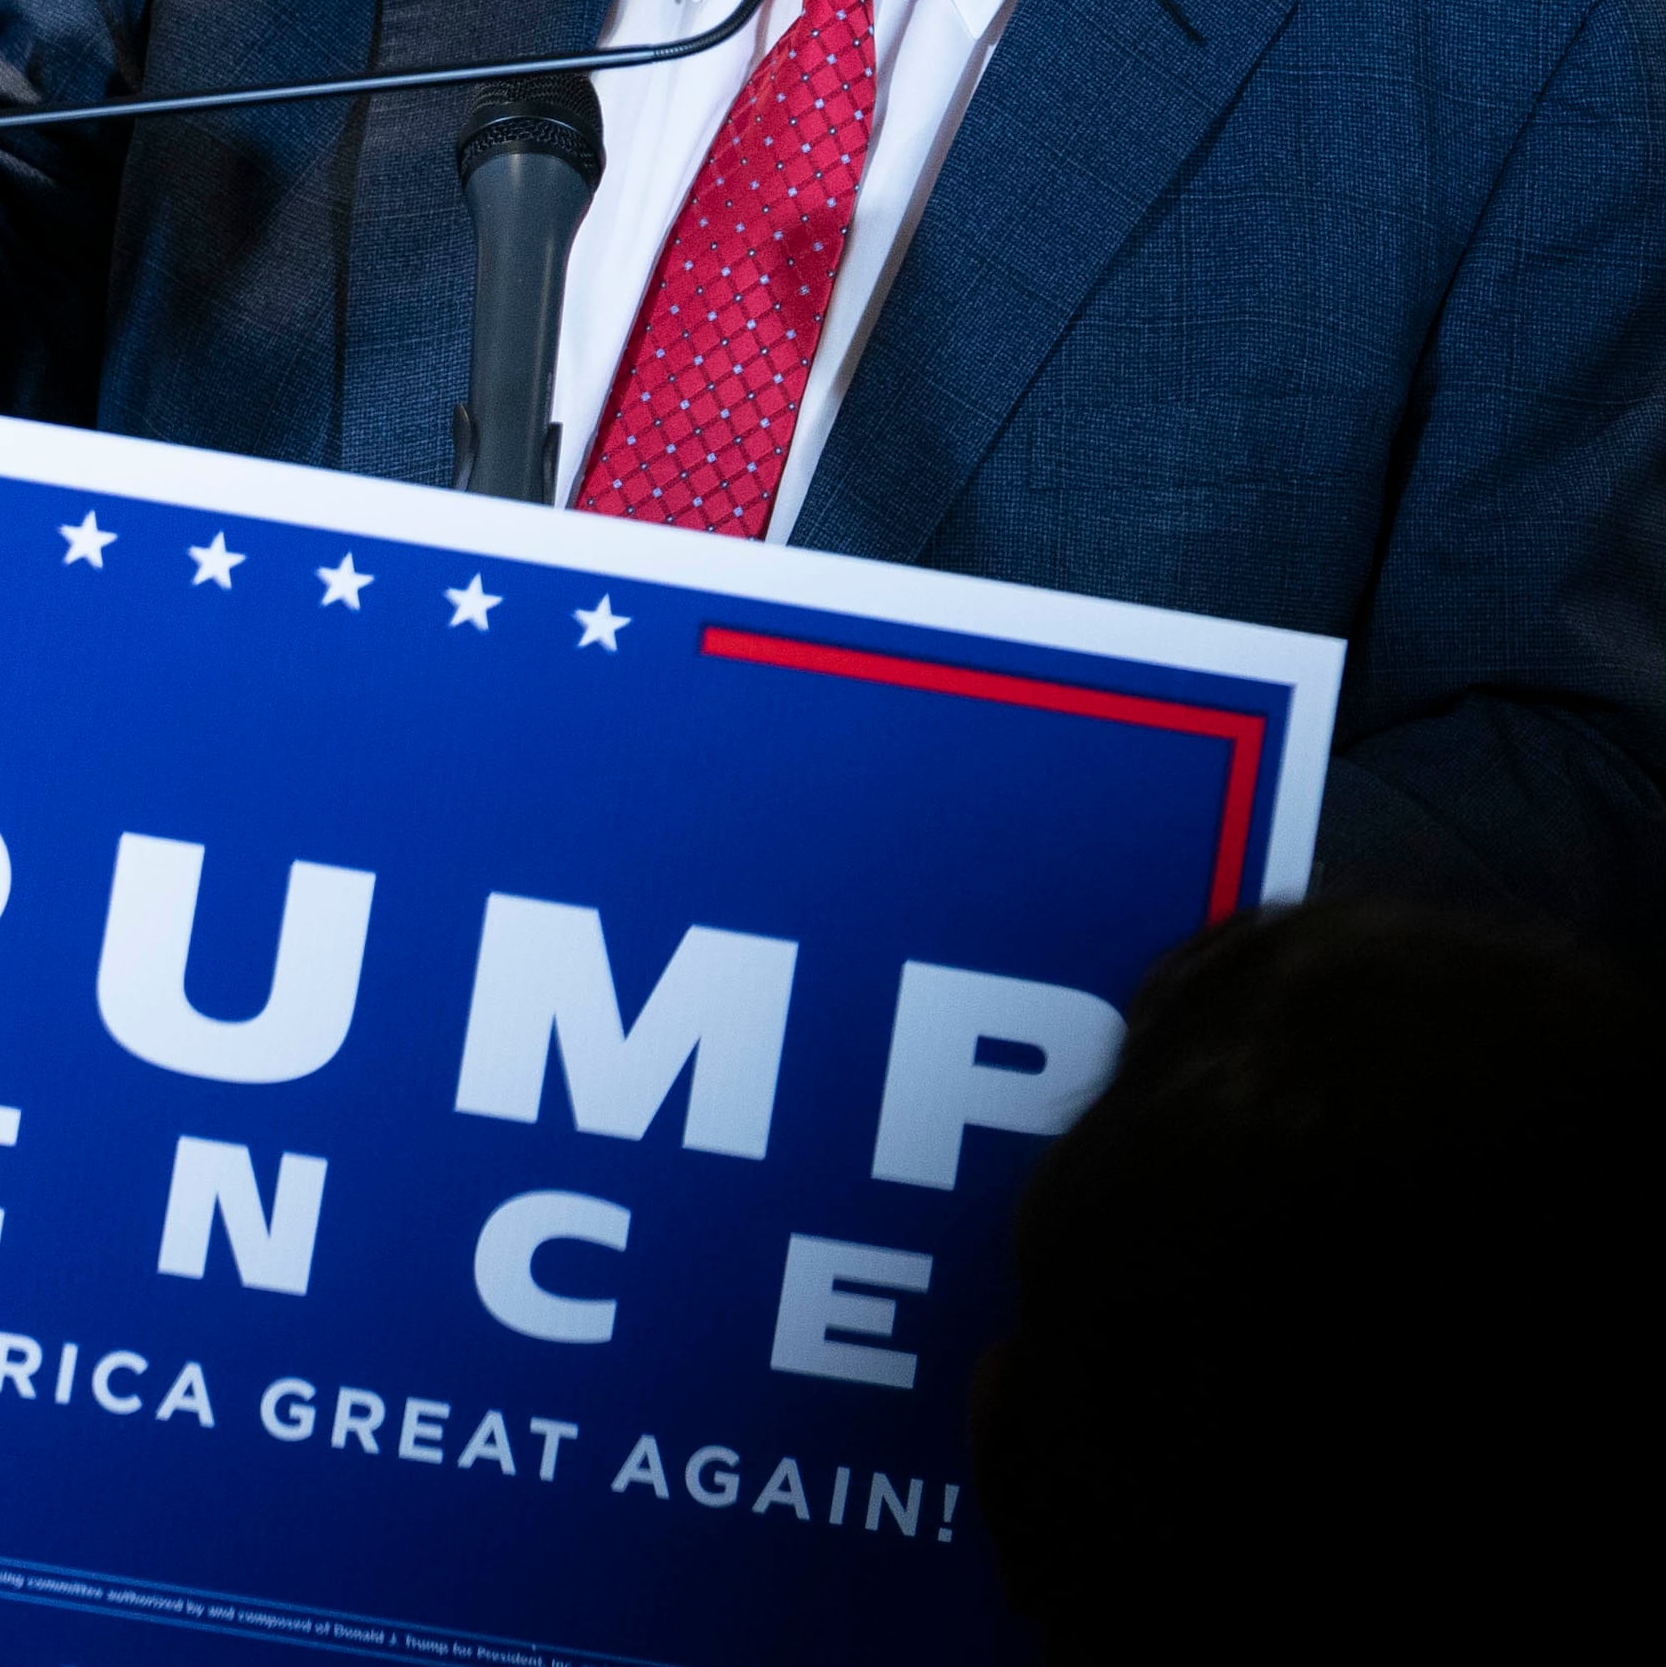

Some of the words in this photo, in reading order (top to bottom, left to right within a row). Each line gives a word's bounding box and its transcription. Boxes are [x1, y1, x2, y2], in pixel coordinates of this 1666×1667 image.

[260, 1379, 580, 1481] GREAT
[613, 1437, 960, 1543] AGAIN!
[27, 1575, 104, 1599] committee
[106, 1589, 184, 1613] authorized
[186, 1598, 205, 1617] by
[207, 1605, 235, 1621] and
[237, 1611, 312, 1634] composed
[314, 1621, 331, 1636] of
[333, 1623, 384, 1645] Donald
[404, 1634, 449, 1657] Trump
[452, 1641, 473, 1657] for
